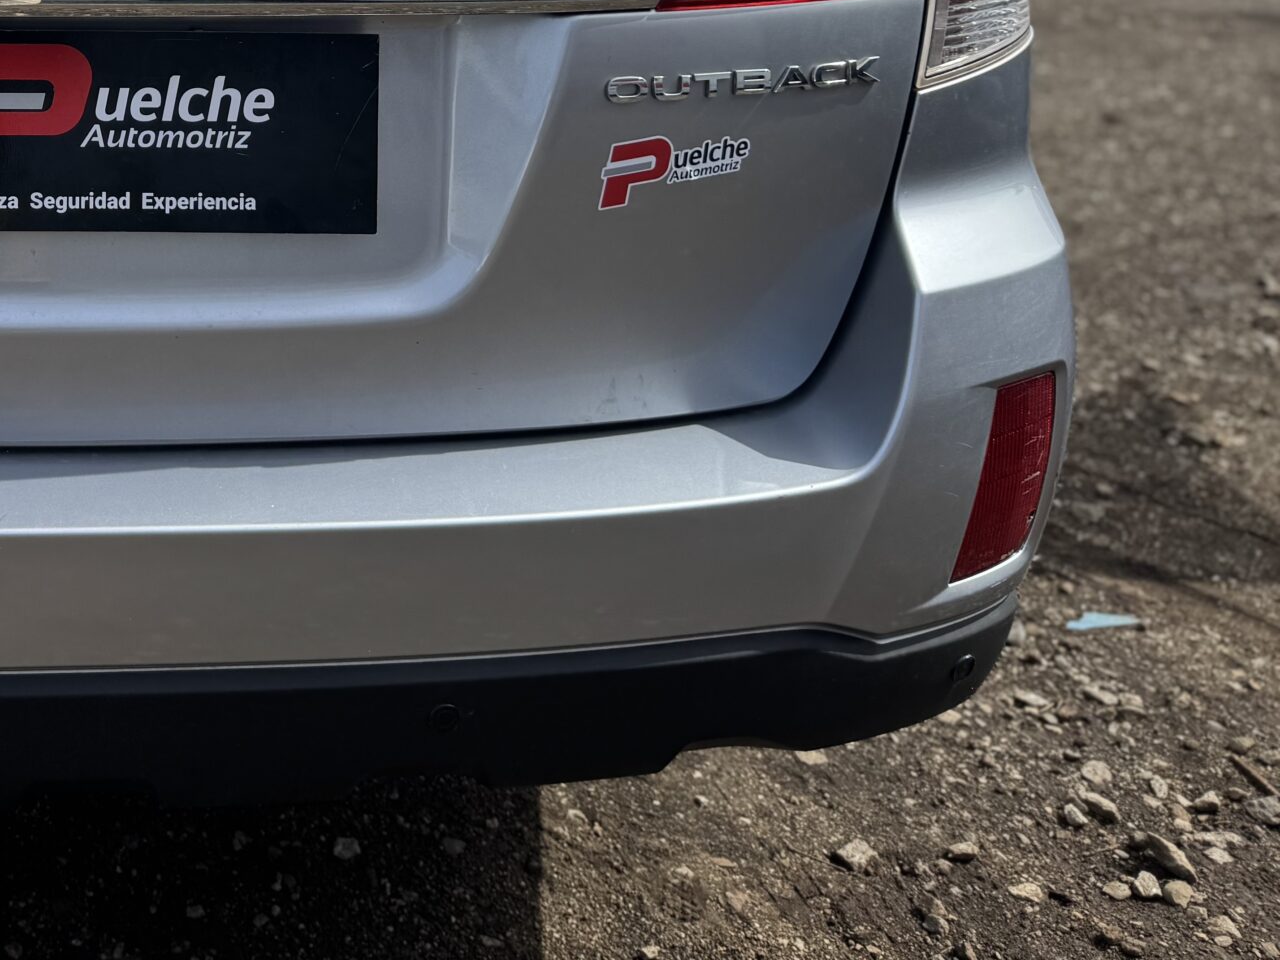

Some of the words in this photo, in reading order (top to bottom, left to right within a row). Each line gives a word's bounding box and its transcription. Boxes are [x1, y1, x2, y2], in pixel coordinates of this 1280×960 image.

[605, 56, 880, 104] OUTBACK
[80, 124, 252, 149] Automotriz
[668, 159, 741, 183] Automotriz
[30, 192, 131, 213] Seguridad
[141, 192, 257, 214] Experiencia
